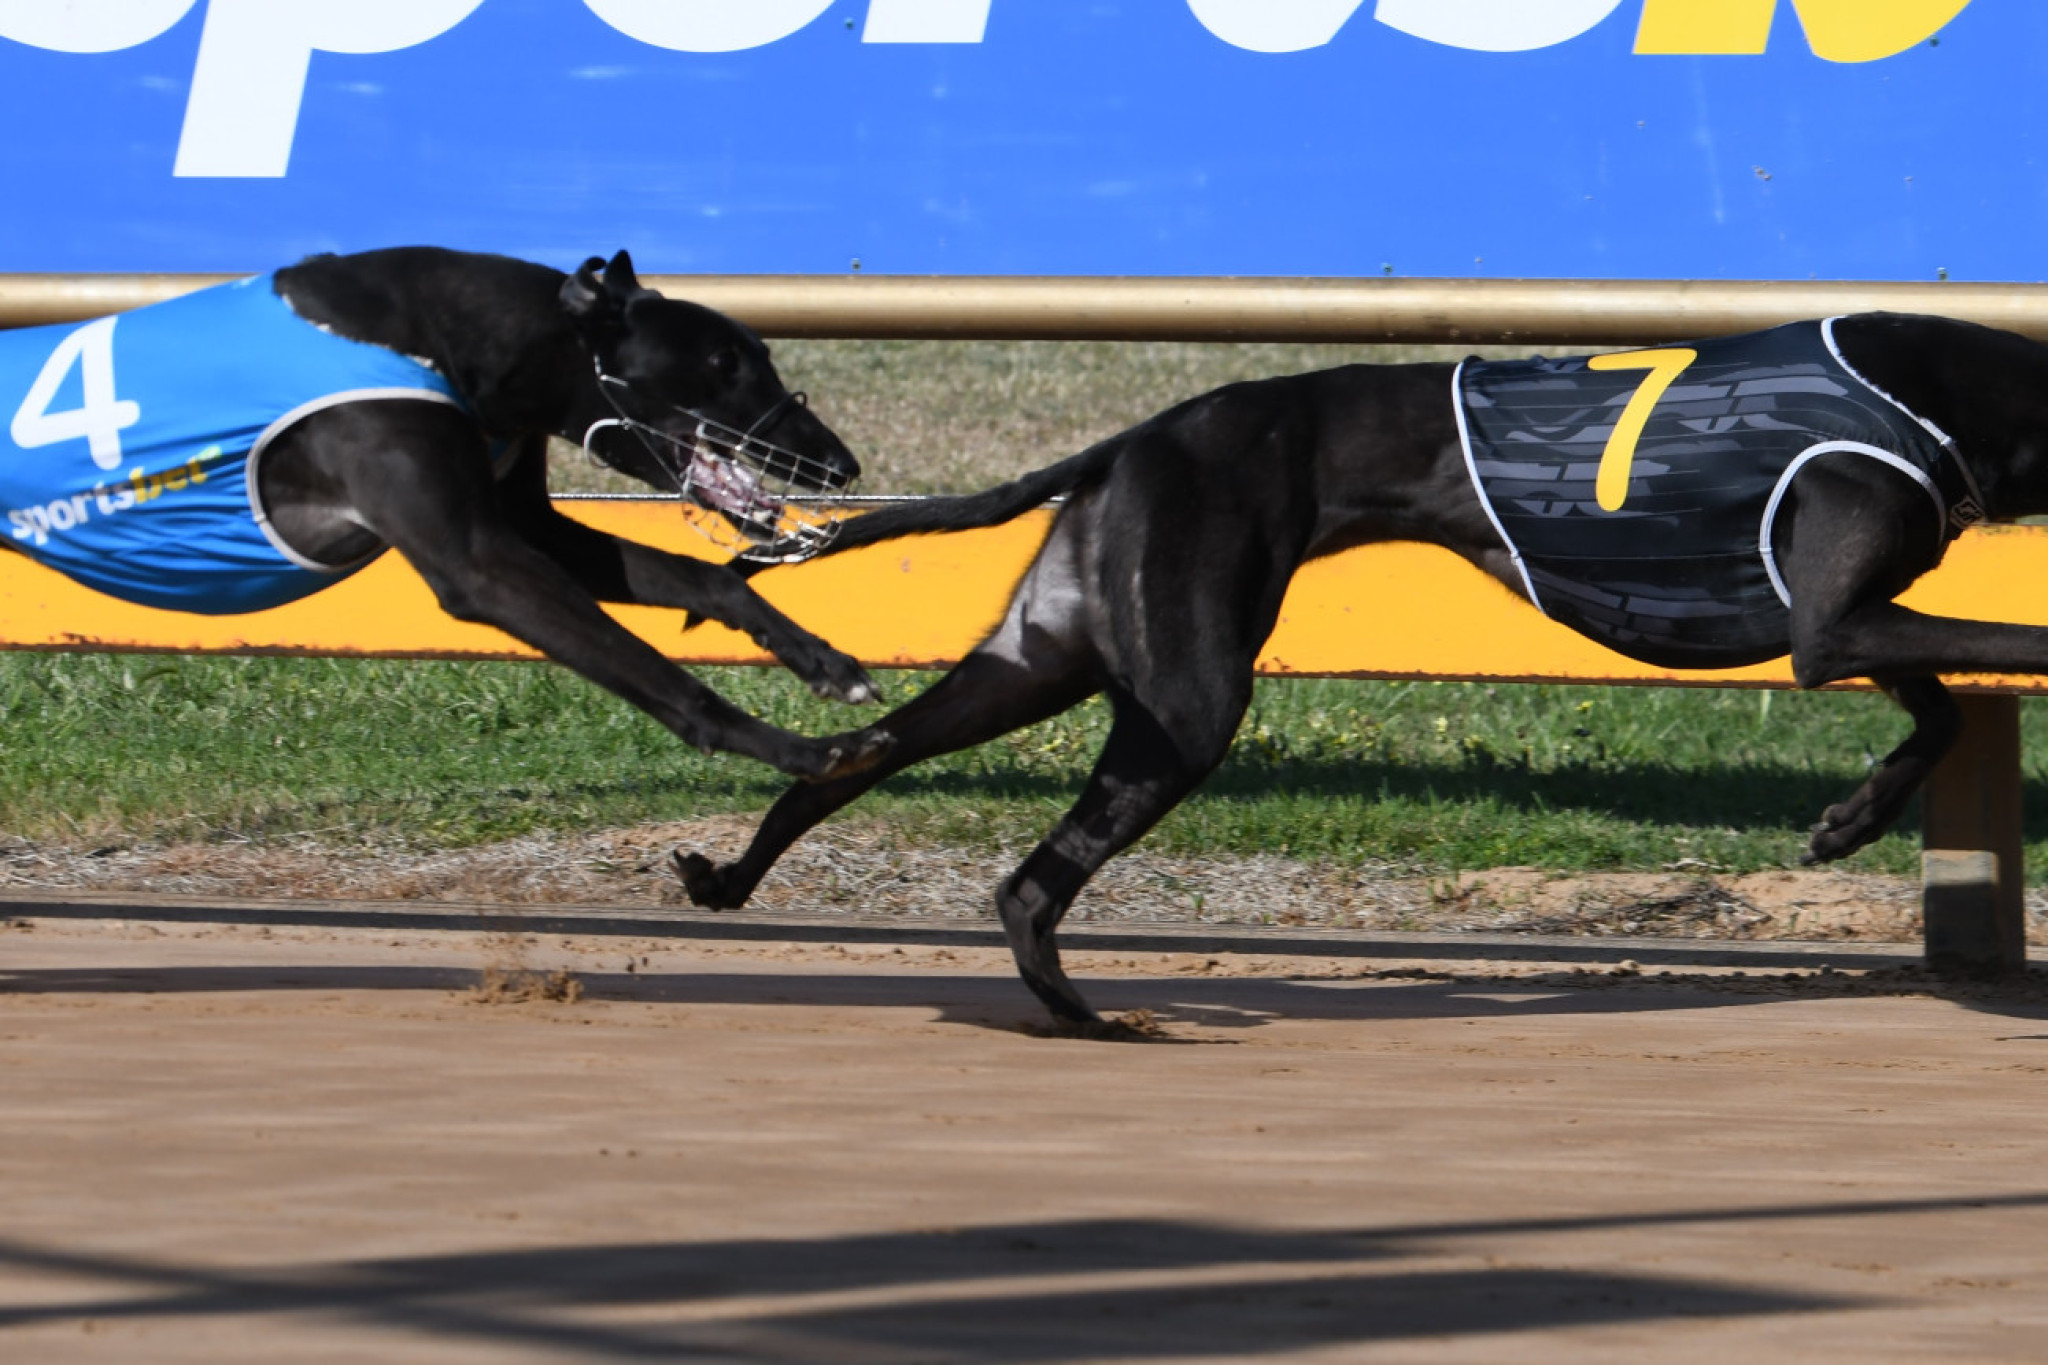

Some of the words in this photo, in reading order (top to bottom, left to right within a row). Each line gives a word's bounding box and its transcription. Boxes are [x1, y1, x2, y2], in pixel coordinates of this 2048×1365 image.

[11, 315, 140, 470] 4
[1587, 348, 1698, 512] 7
[8, 455, 209, 546] sportsbet
